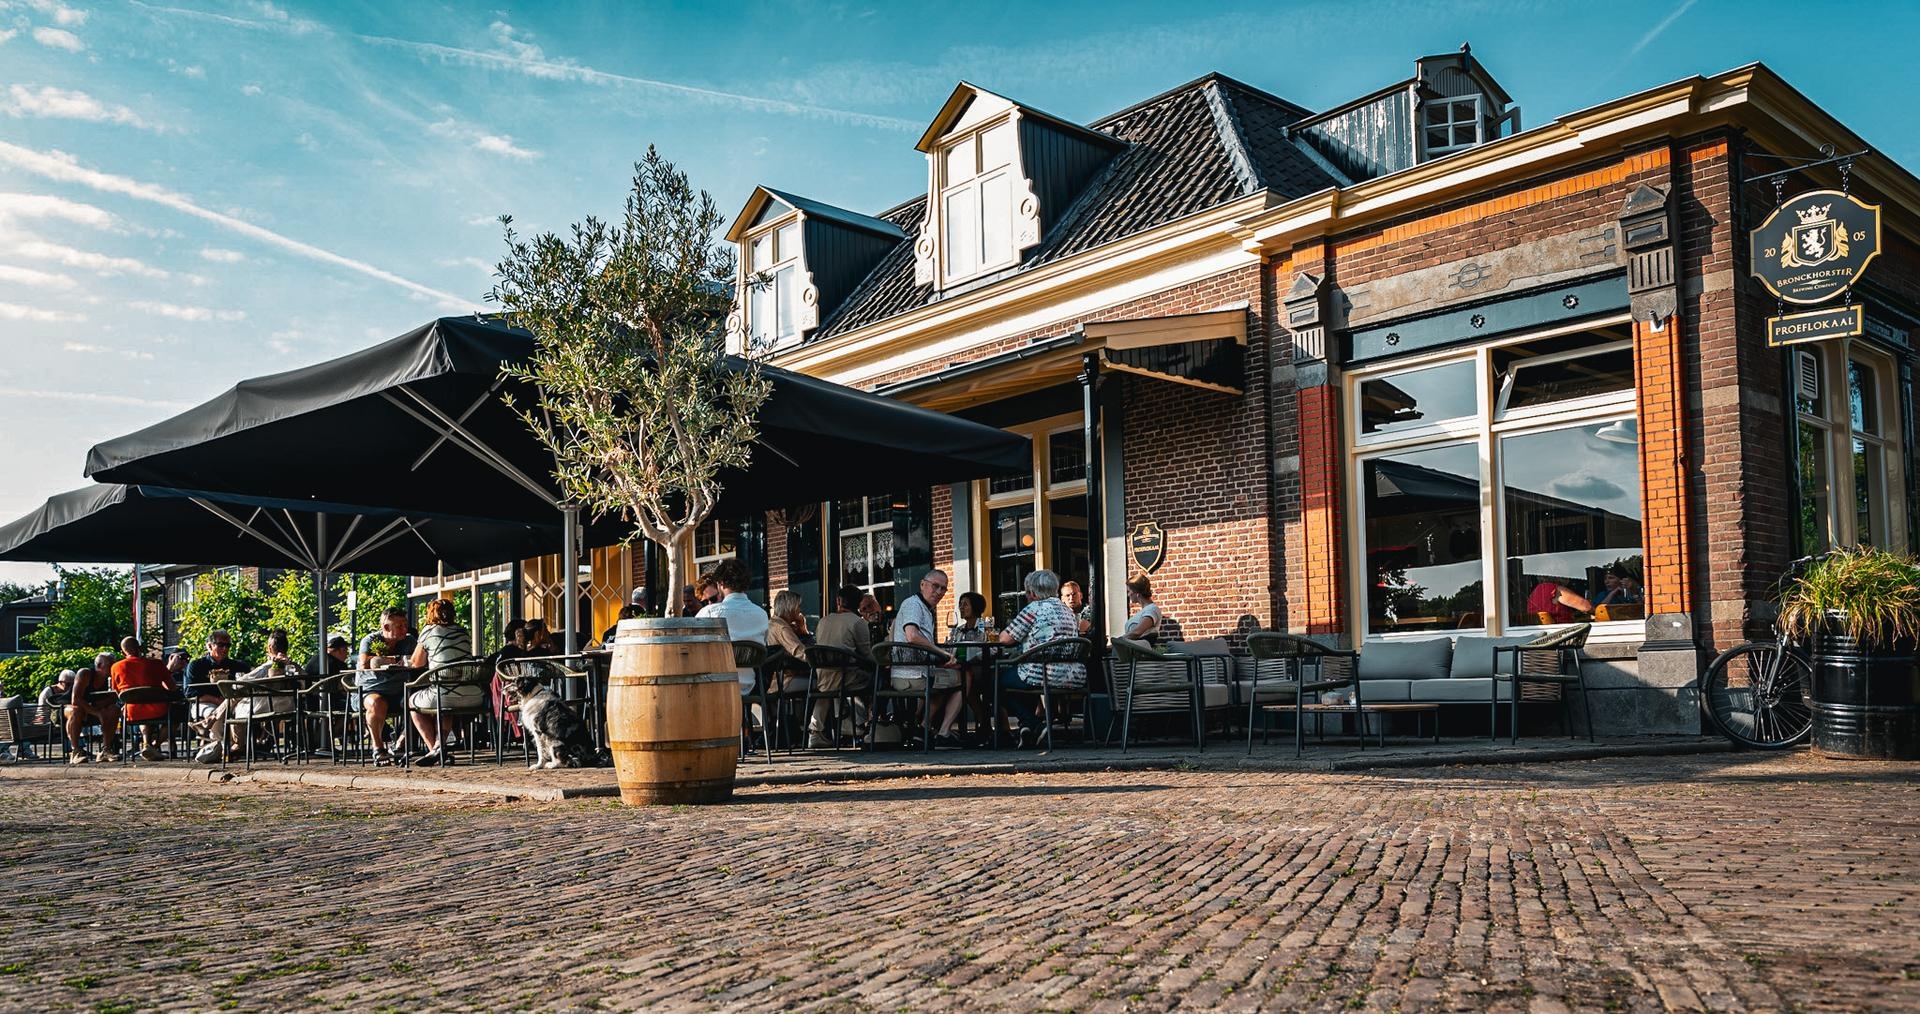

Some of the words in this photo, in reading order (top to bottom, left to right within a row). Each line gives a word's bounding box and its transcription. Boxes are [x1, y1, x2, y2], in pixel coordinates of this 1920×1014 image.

[1764, 247, 1776, 258] 20
[1853, 231, 1866, 241] 05
[1776, 267, 1853, 288] BRONCKHORSTER
[1775, 317, 1855, 336] PROEFLOKAAL
